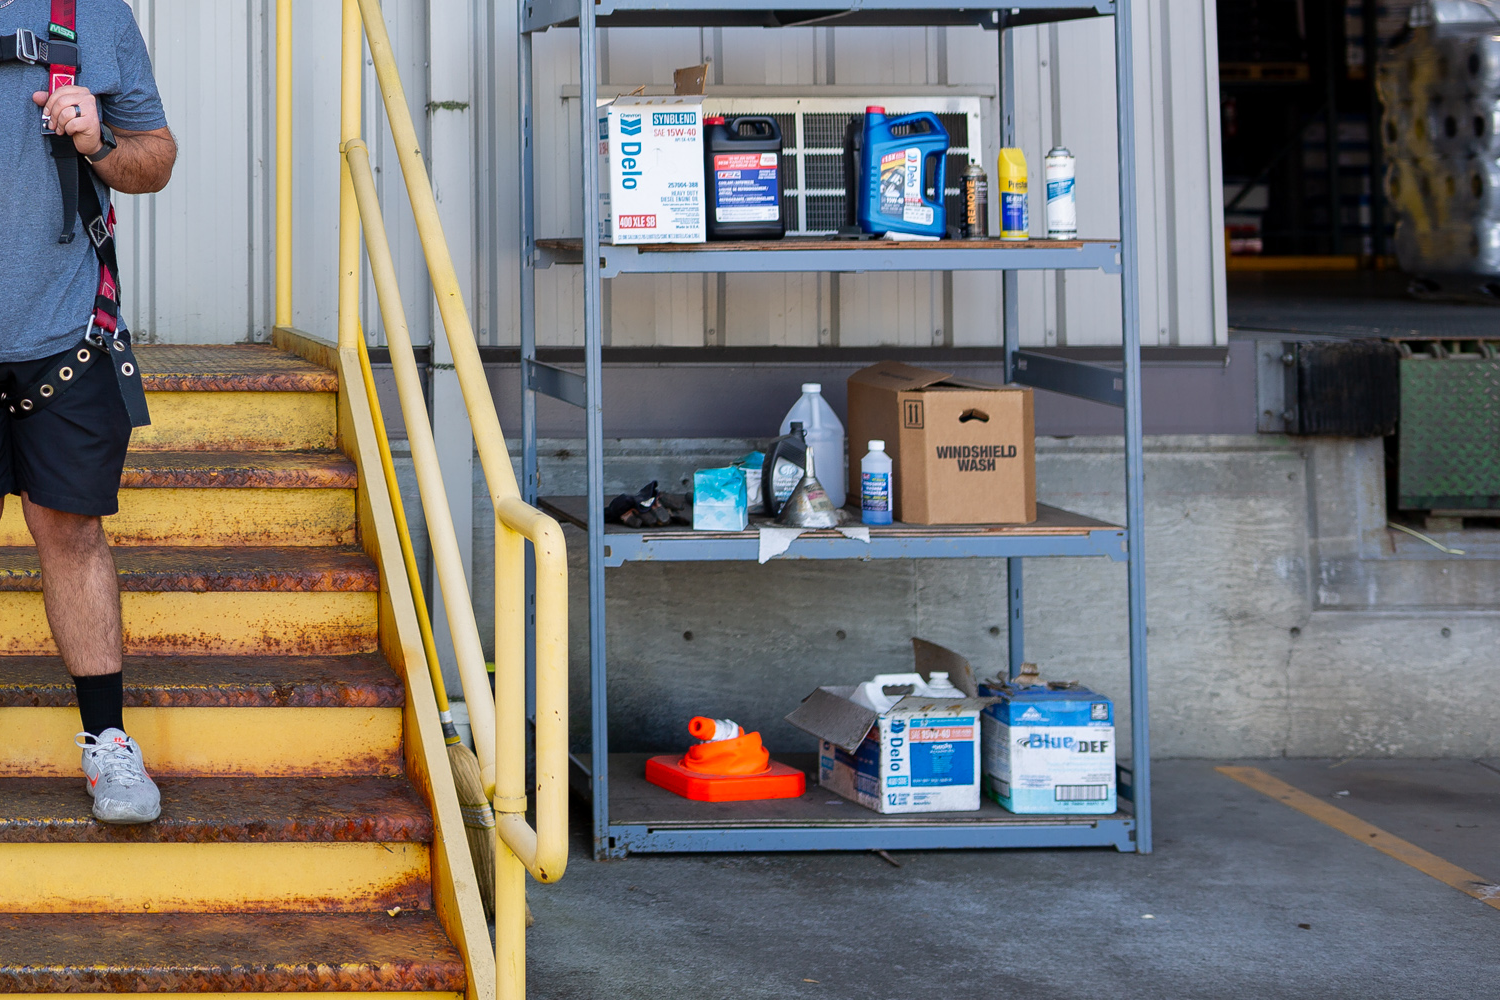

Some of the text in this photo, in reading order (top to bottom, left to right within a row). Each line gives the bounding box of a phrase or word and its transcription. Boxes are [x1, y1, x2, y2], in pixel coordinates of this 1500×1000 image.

[50, 24, 75, 40] MSA
[653, 113, 696, 125] SYNBLEND
[667, 129, 696, 137] 15W-40
[621, 142, 642, 190] Delo
[907, 165, 918, 188] Delo
[966, 180, 976, 225] REMOVE
[620, 216, 656, 227] 400 XLE SB
[936, 445, 1017, 458] WINDSHIELD
[957, 459, 996, 471] WASH
[1030, 734, 1109, 753] Blue DEF
[890, 738, 903, 771] Delo
[888, 794, 897, 805] 12
